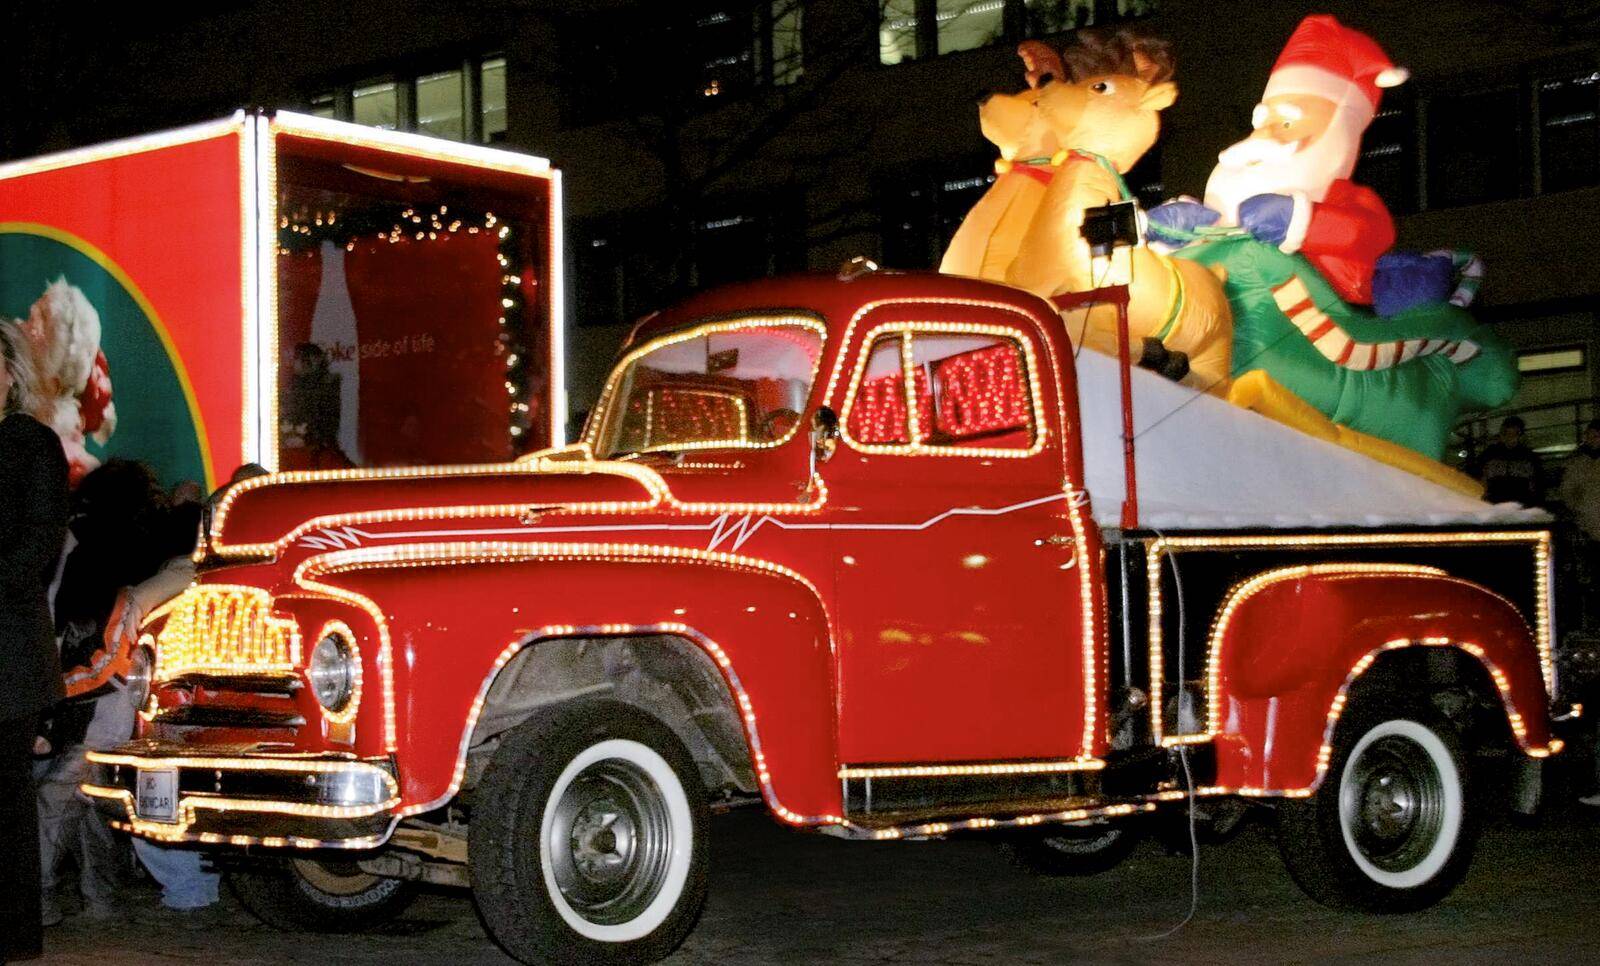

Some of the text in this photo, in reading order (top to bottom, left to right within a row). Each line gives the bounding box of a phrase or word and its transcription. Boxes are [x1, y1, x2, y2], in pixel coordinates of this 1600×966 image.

[360, 340, 391, 359] side
[393, 335, 409, 356] of
[412, 332, 434, 352] life
